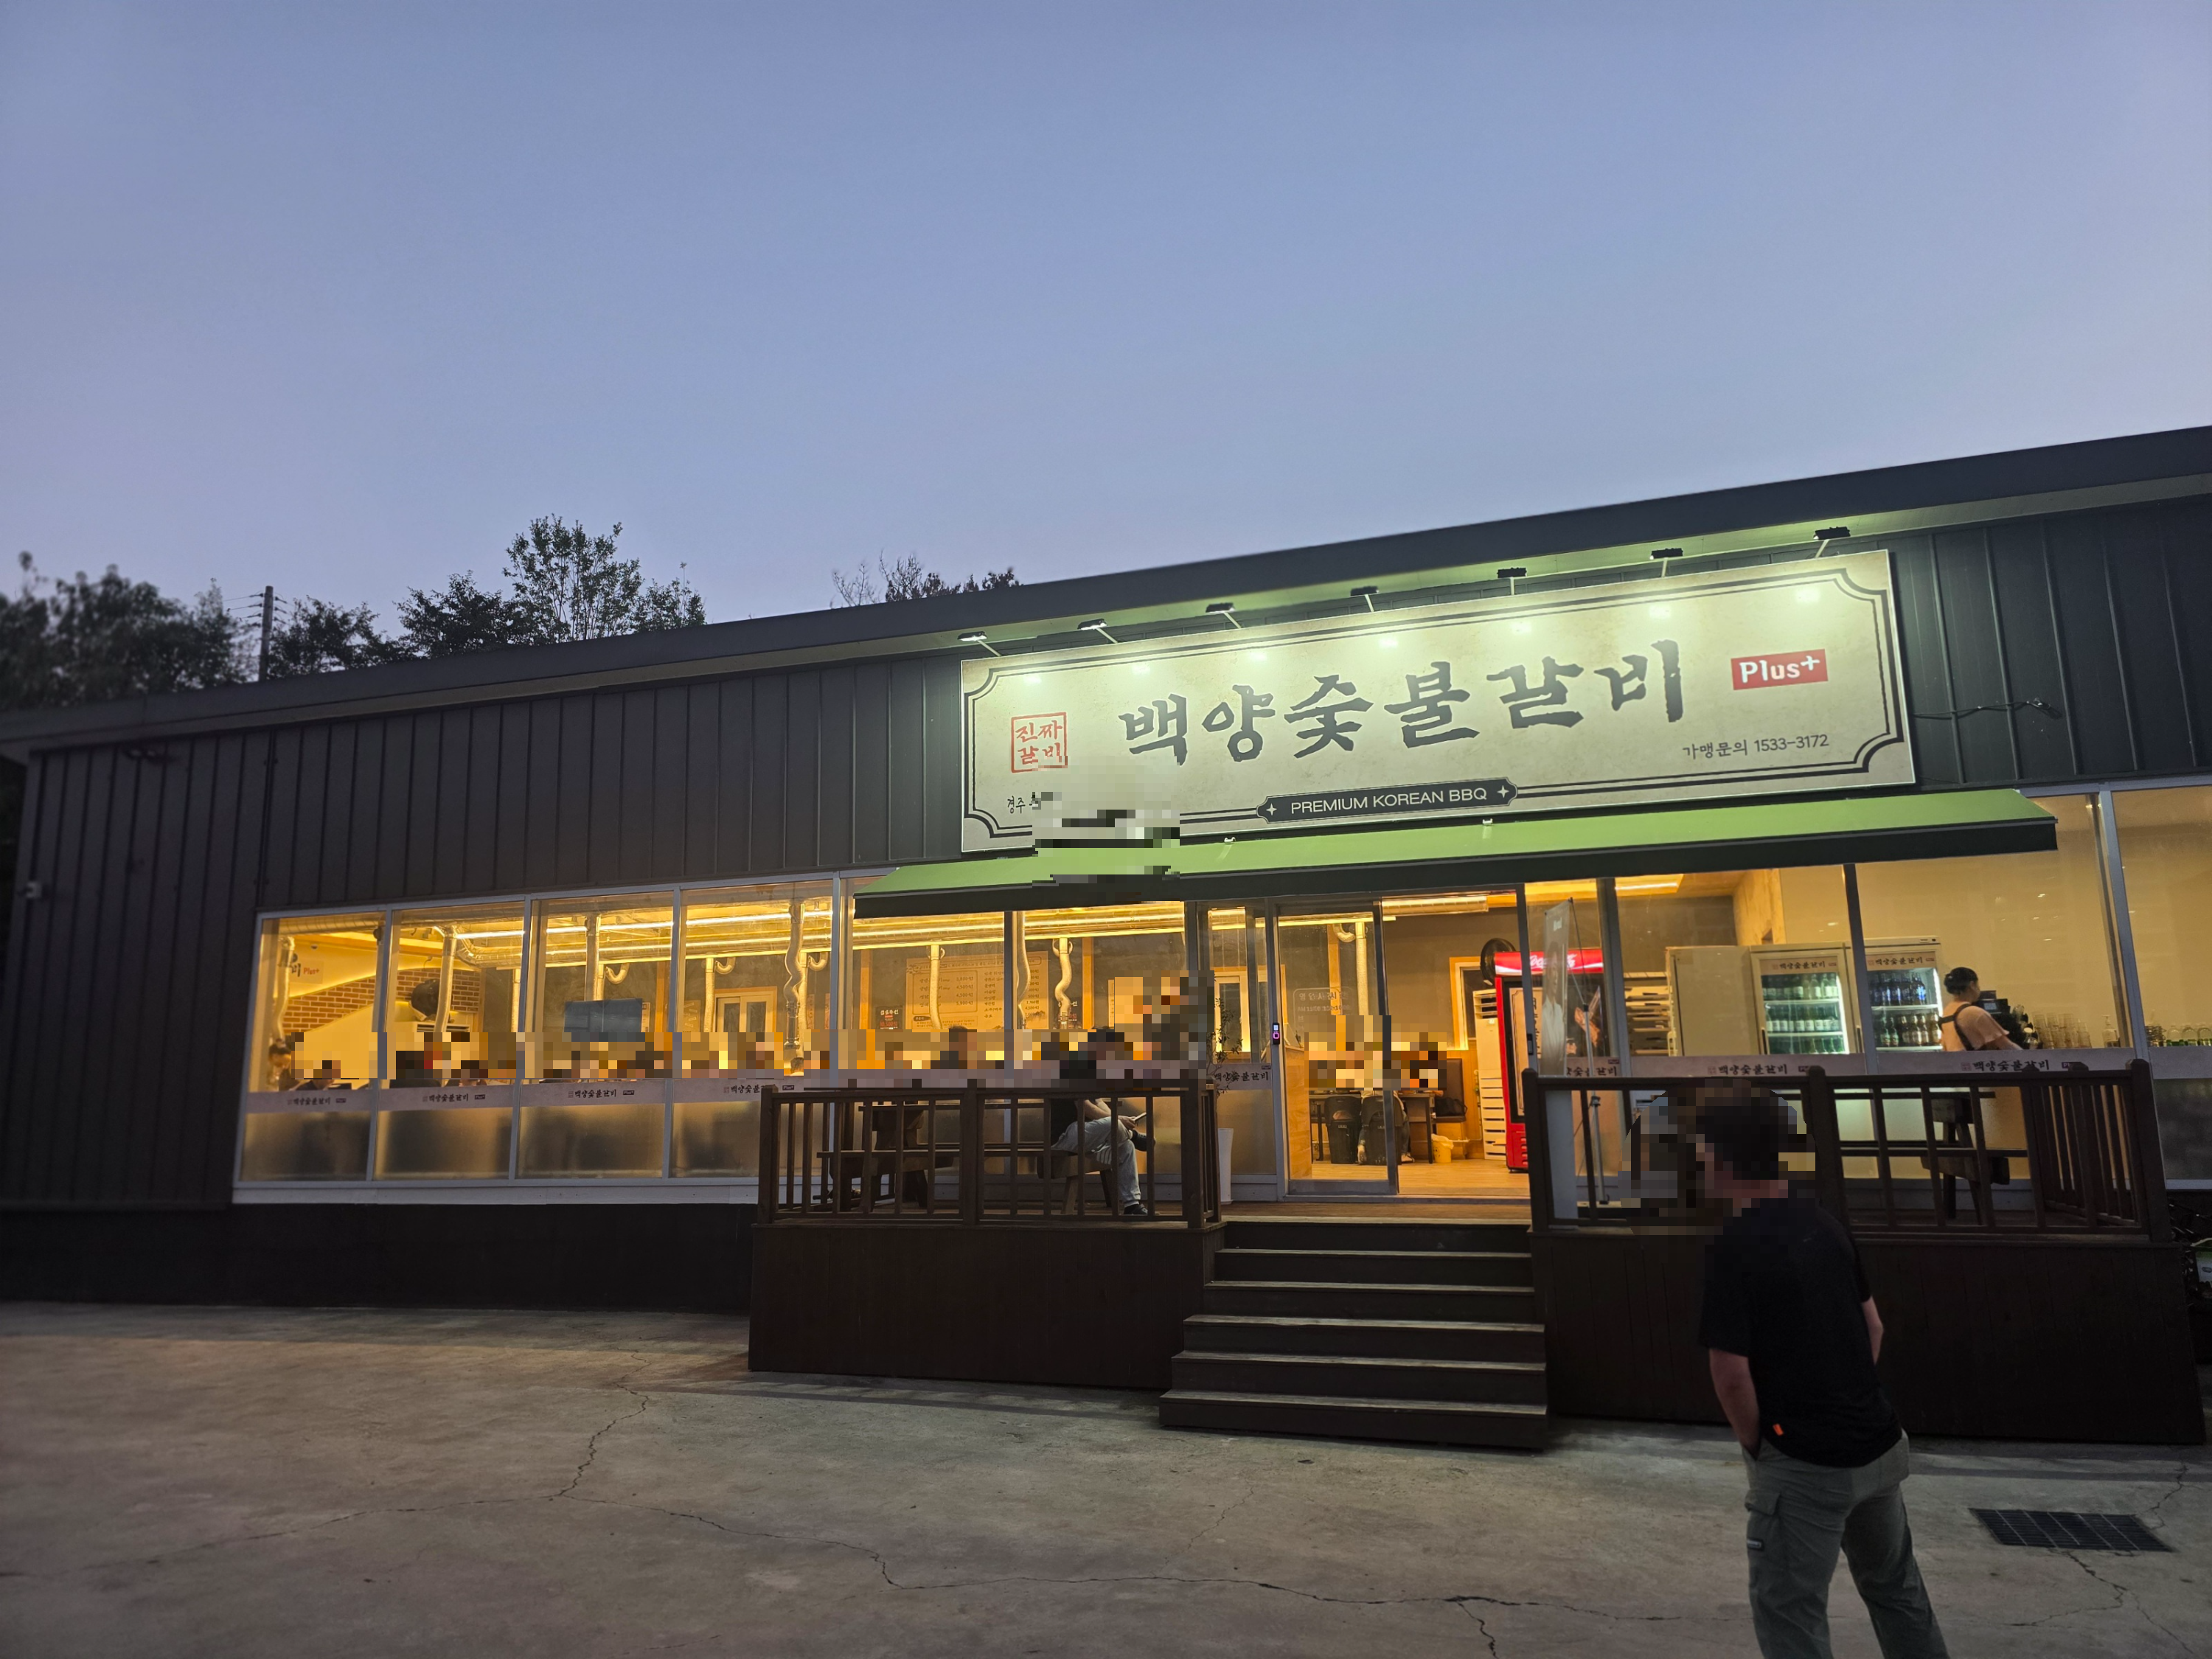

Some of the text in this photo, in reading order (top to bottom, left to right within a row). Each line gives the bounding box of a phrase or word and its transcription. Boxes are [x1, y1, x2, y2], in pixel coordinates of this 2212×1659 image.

[1118, 639, 1684, 765] 백양숯불갈비
[1015, 720, 1062, 742] 진짜
[1683, 734, 1829, 759] 가맹문의 1533-3172
[1007, 796, 1026, 814] 경주
[1291, 788, 1487, 814] PREMIUM KOREAN BBQ
[1719, 1064, 1787, 1075] 백양숯불갈비
